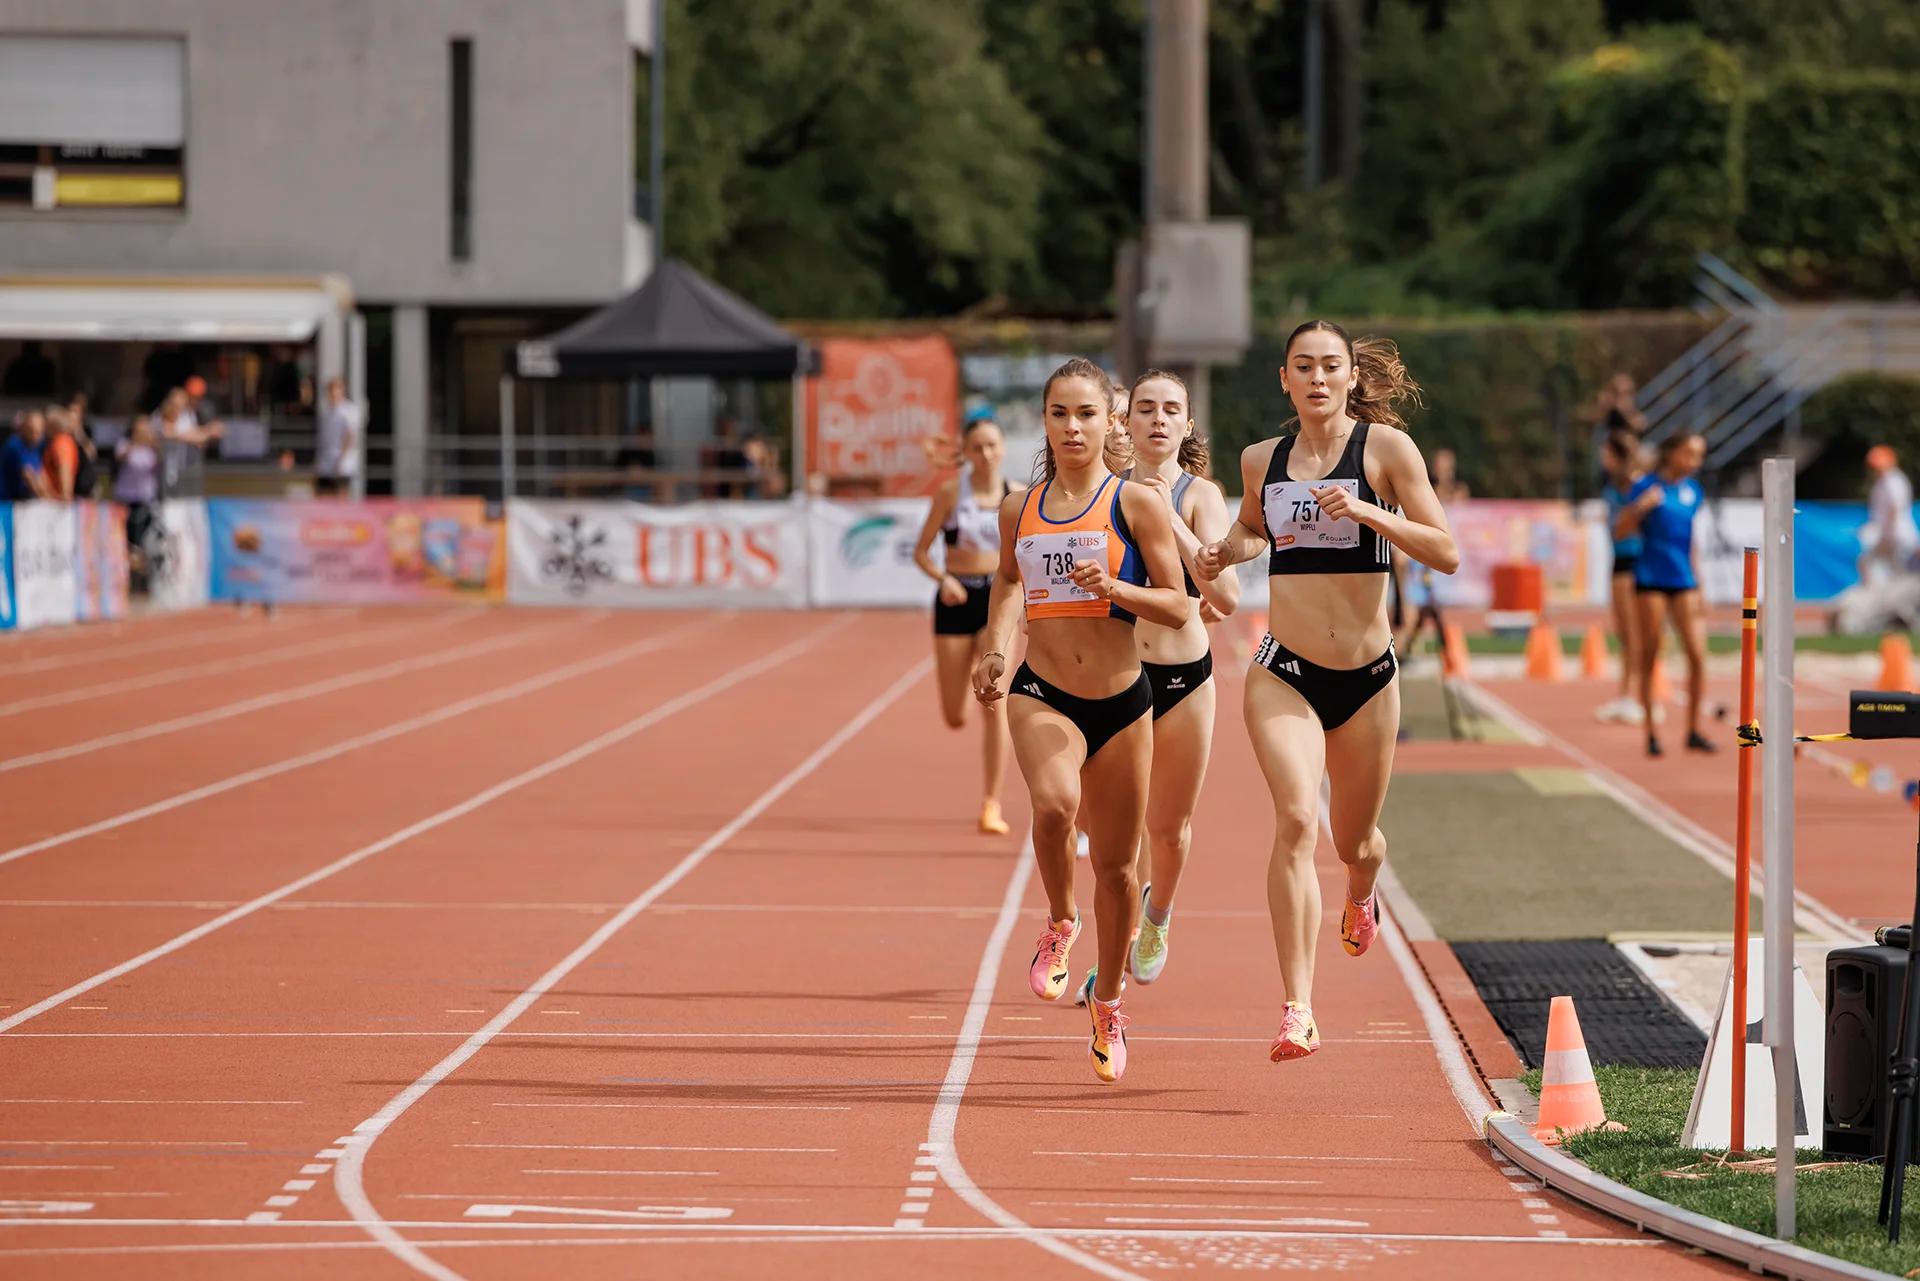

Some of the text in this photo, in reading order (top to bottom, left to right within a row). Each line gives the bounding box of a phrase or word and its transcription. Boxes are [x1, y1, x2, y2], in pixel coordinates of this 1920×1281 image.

[1291, 500, 1321, 522] 757
[1078, 537, 1099, 546] UBS
[635, 524, 779, 588] UBS
[1043, 552, 1074, 576] 738
[1878, 703, 1906, 712] TIMING
